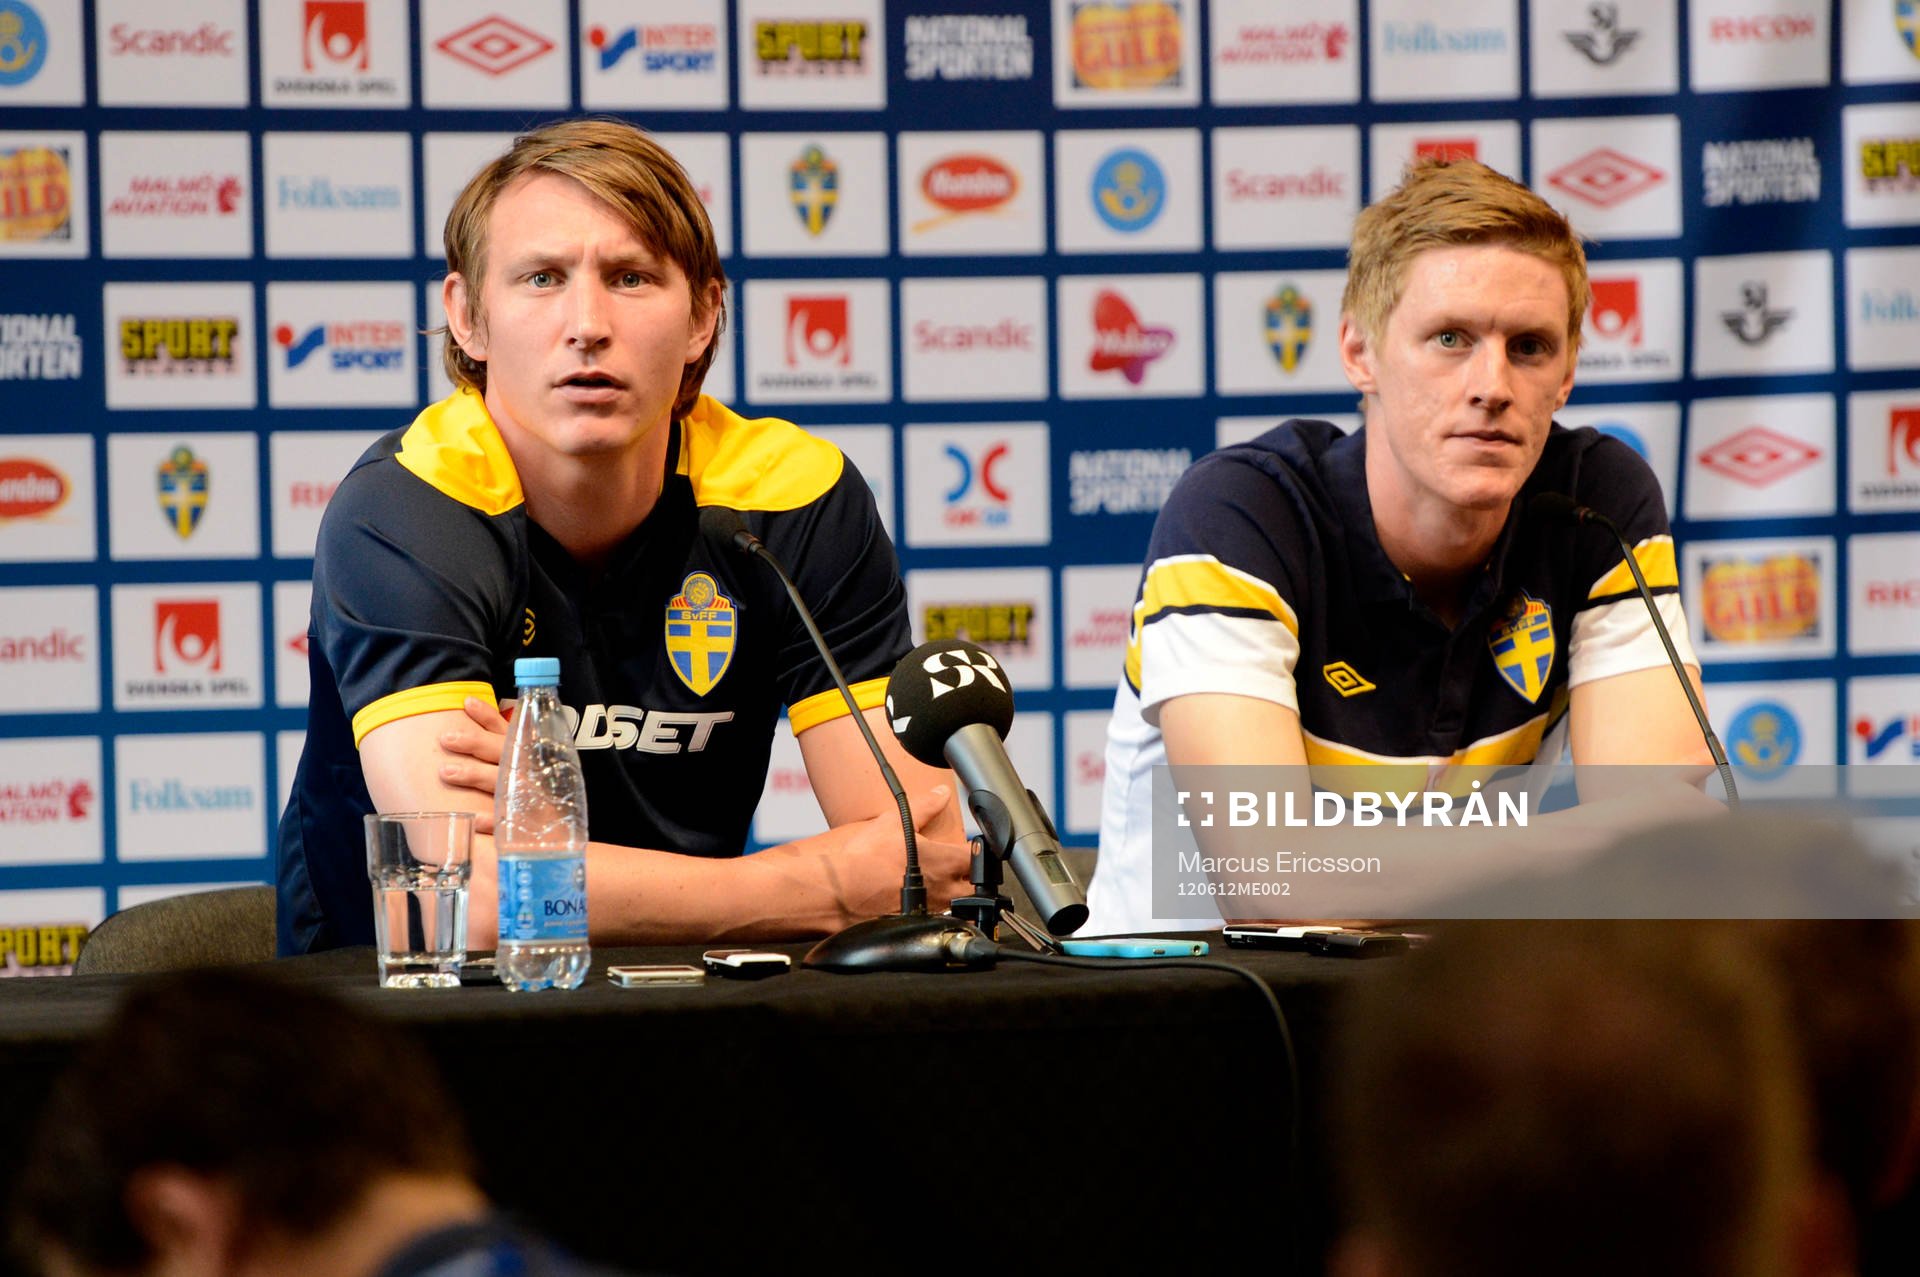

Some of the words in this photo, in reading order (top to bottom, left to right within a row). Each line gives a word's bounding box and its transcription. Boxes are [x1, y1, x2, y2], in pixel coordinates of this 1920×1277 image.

[109, 24, 233, 57] Scandic
[641, 24, 716, 48] INTER
[754, 21, 868, 63] SPORT
[644, 52, 714, 72] SPORT
[277, 176, 402, 211] Folksam
[1225, 168, 1345, 202] Scandic
[120, 318, 238, 360] SPORT
[328, 321, 405, 347] INTER
[913, 320, 1032, 352] Scandic
[0, 343, 83, 379] RTEN
[332, 349, 404, 372] SPORT
[922, 650, 1008, 700] SR
[129, 779, 254, 813] Folksam
